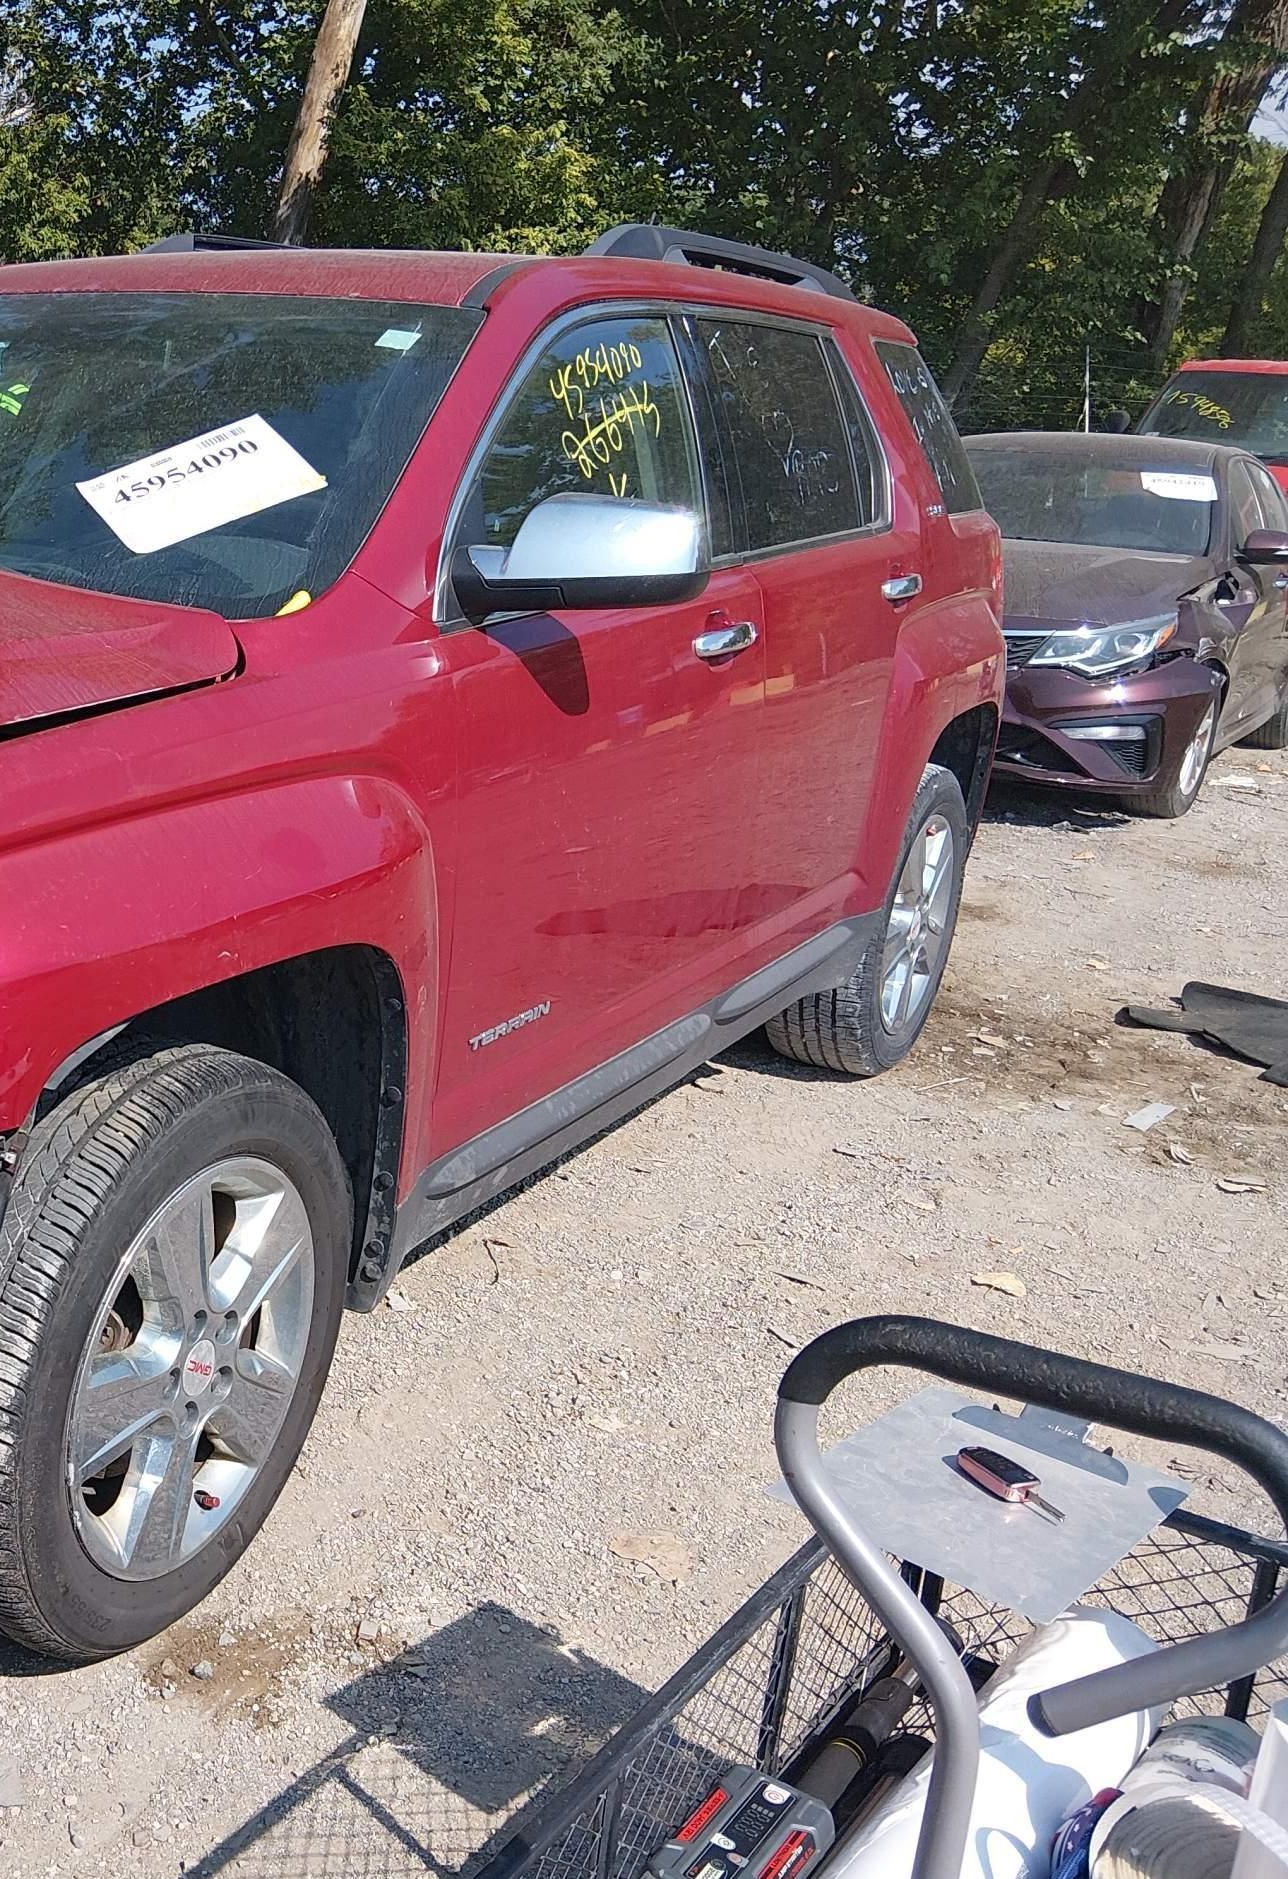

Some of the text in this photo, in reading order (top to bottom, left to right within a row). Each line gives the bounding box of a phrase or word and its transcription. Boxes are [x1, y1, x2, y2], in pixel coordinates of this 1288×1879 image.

[550, 342, 642, 420] 45954090
[114, 439, 259, 505] 45954090
[468, 1000, 552, 1052] TERRAIN
[187, 1359, 213, 1377] GMC
